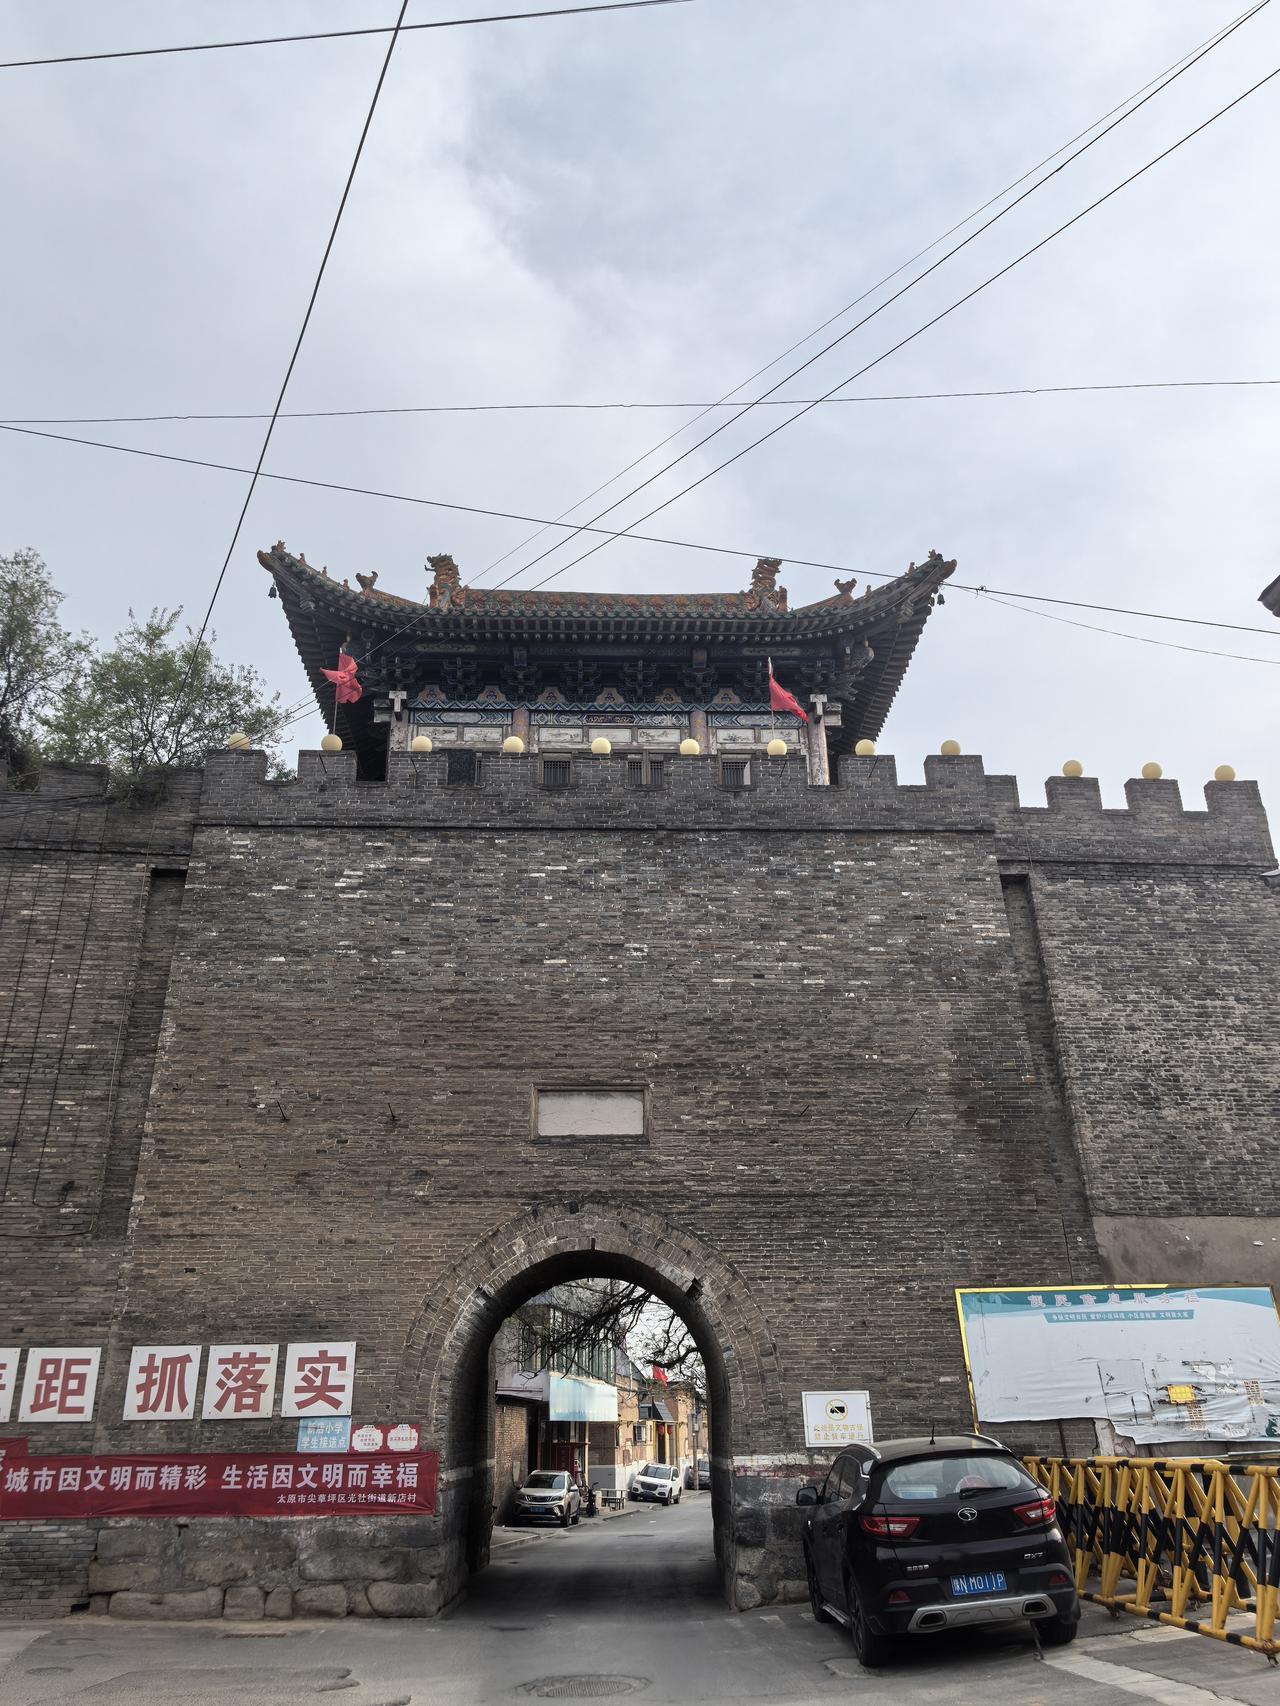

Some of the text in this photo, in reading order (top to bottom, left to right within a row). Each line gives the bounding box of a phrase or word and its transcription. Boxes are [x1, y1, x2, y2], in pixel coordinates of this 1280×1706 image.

[135, 1350, 348, 1413] 抓落实
[306, 1422, 344, 1435] 新店小学
[301, 1435, 346, 1449] 学生接送点
[5, 1462, 420, 1492] 城市因文明而精彩 生活因文明而幸福
[277, 1492, 417, 1505] 太原市尖草坪区光社街道新店村
